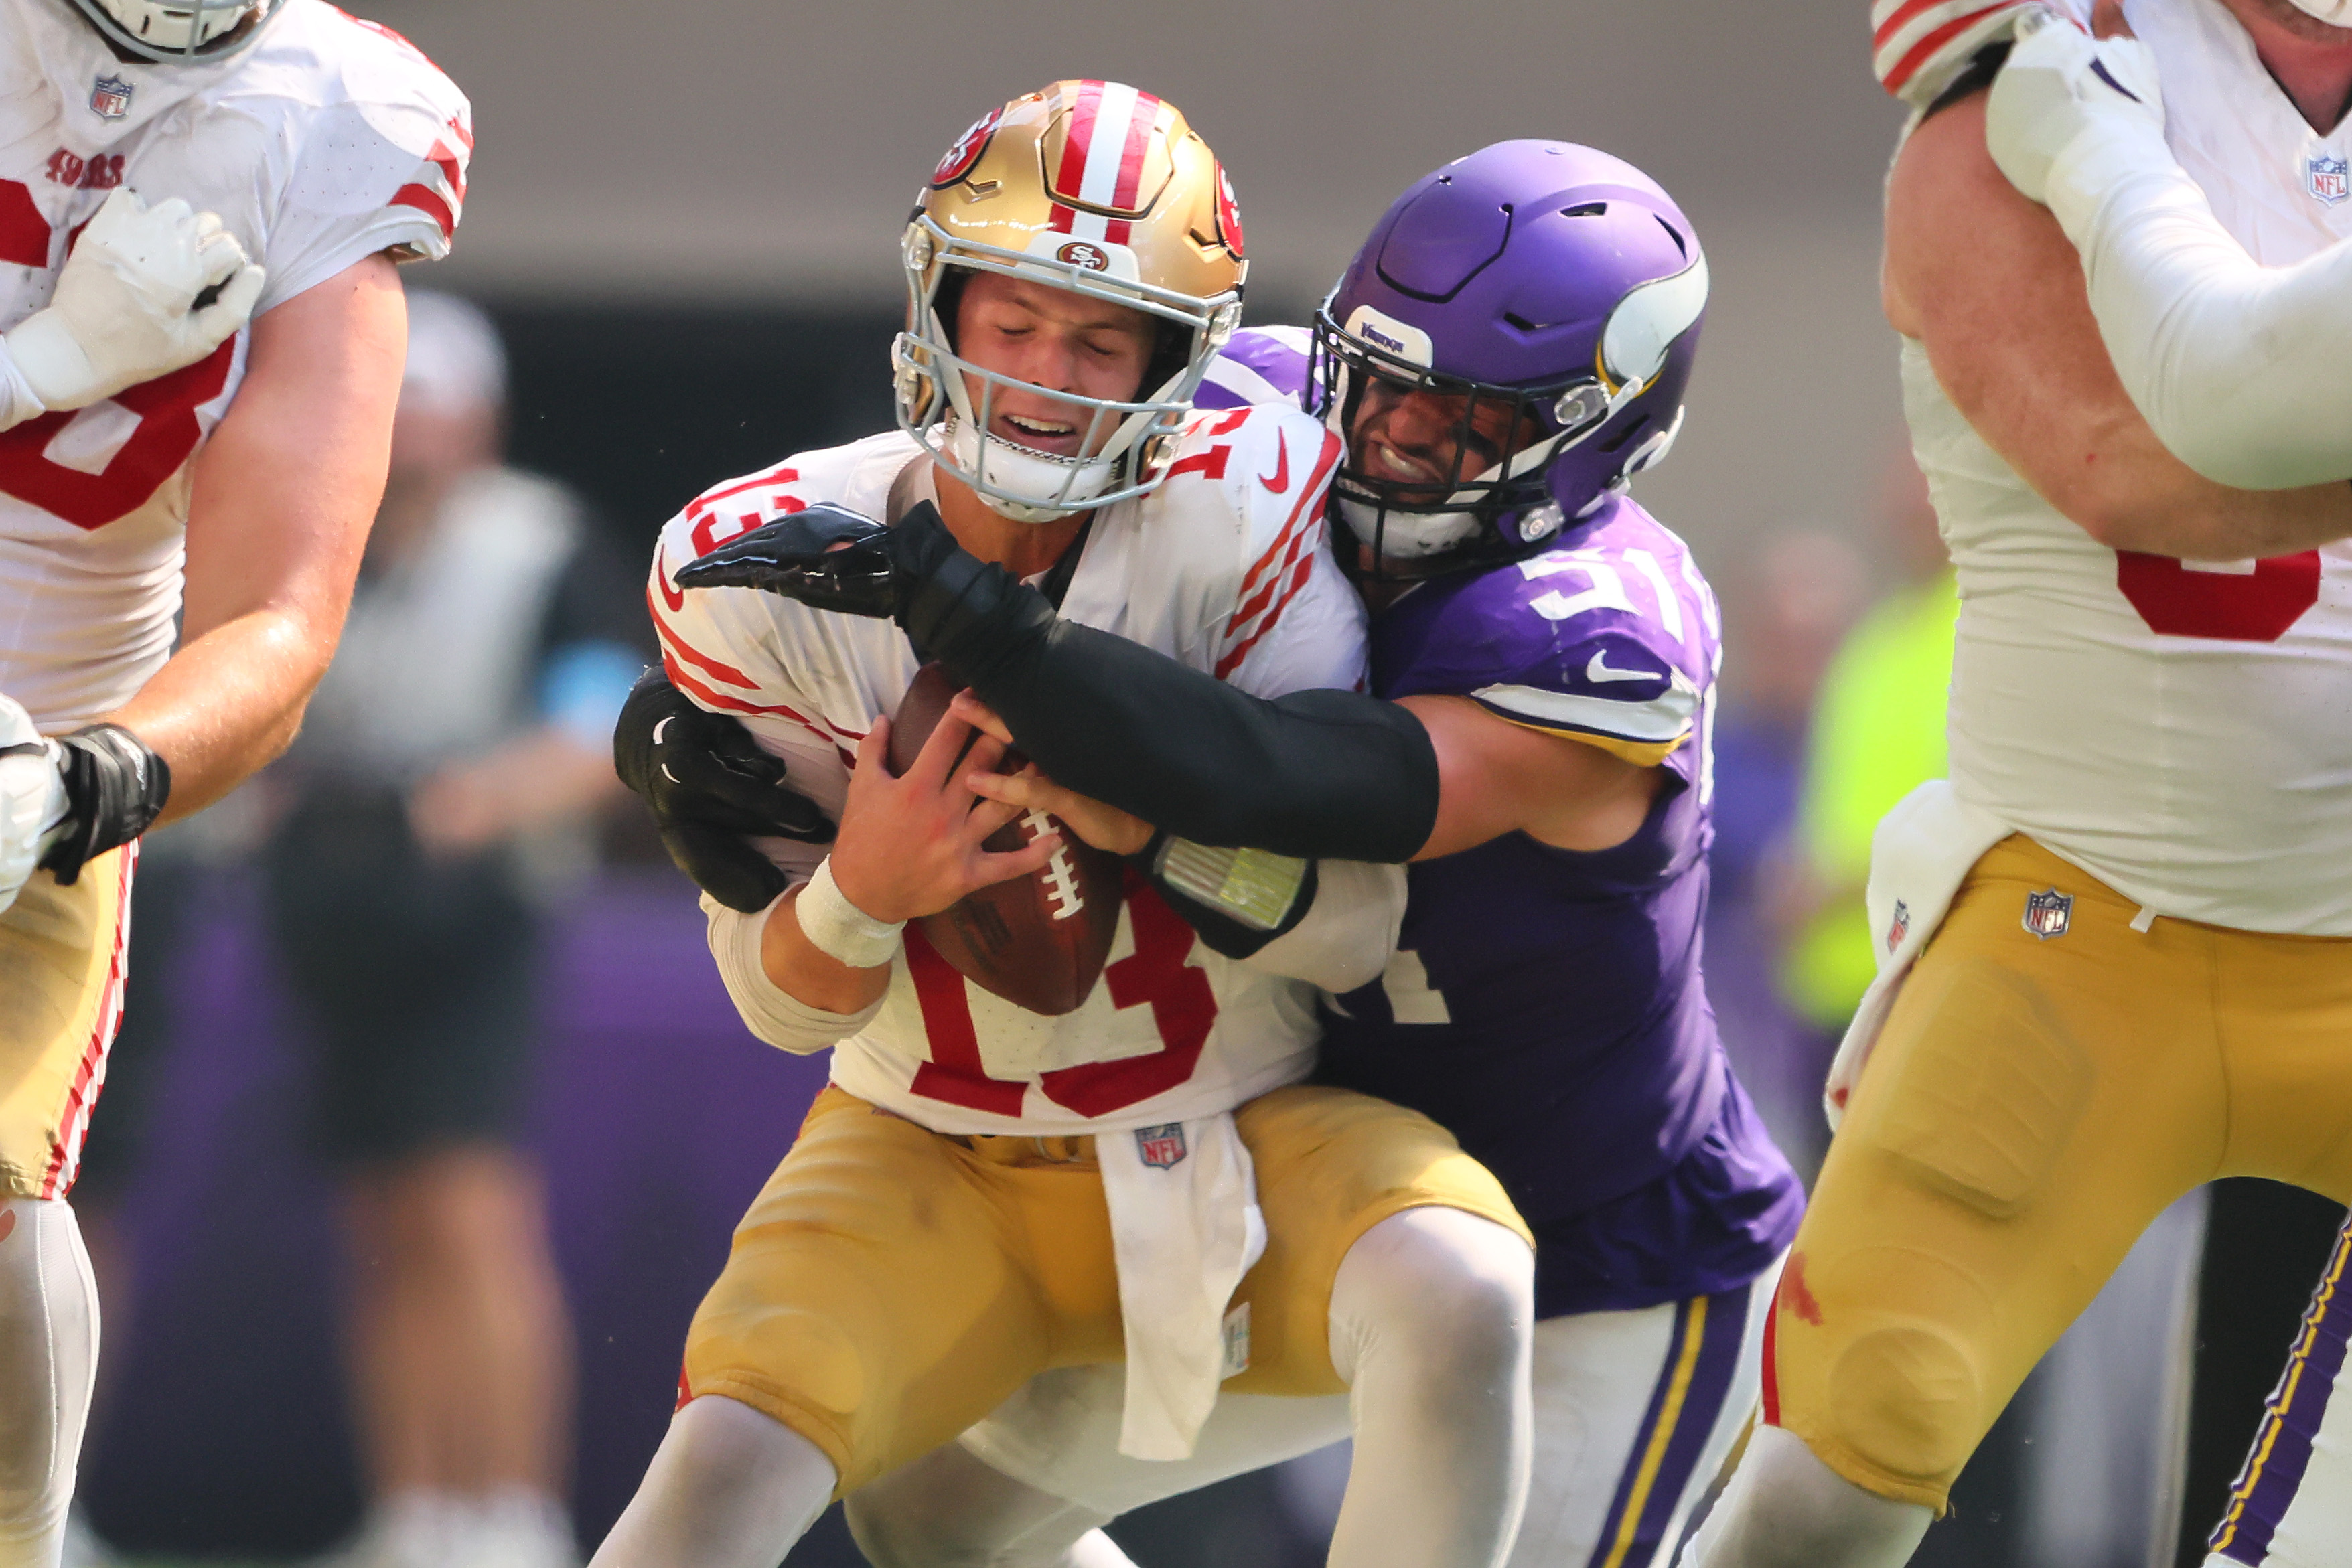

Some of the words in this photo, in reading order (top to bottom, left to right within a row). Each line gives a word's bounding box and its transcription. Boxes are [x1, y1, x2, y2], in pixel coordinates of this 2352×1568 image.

[2314, 174, 2346, 195] NFL
[1516, 546, 1684, 645] 51
[2031, 909, 2064, 931] NFL
[903, 864, 1219, 1119] 13
[1142, 1139, 1185, 1164] NFL
